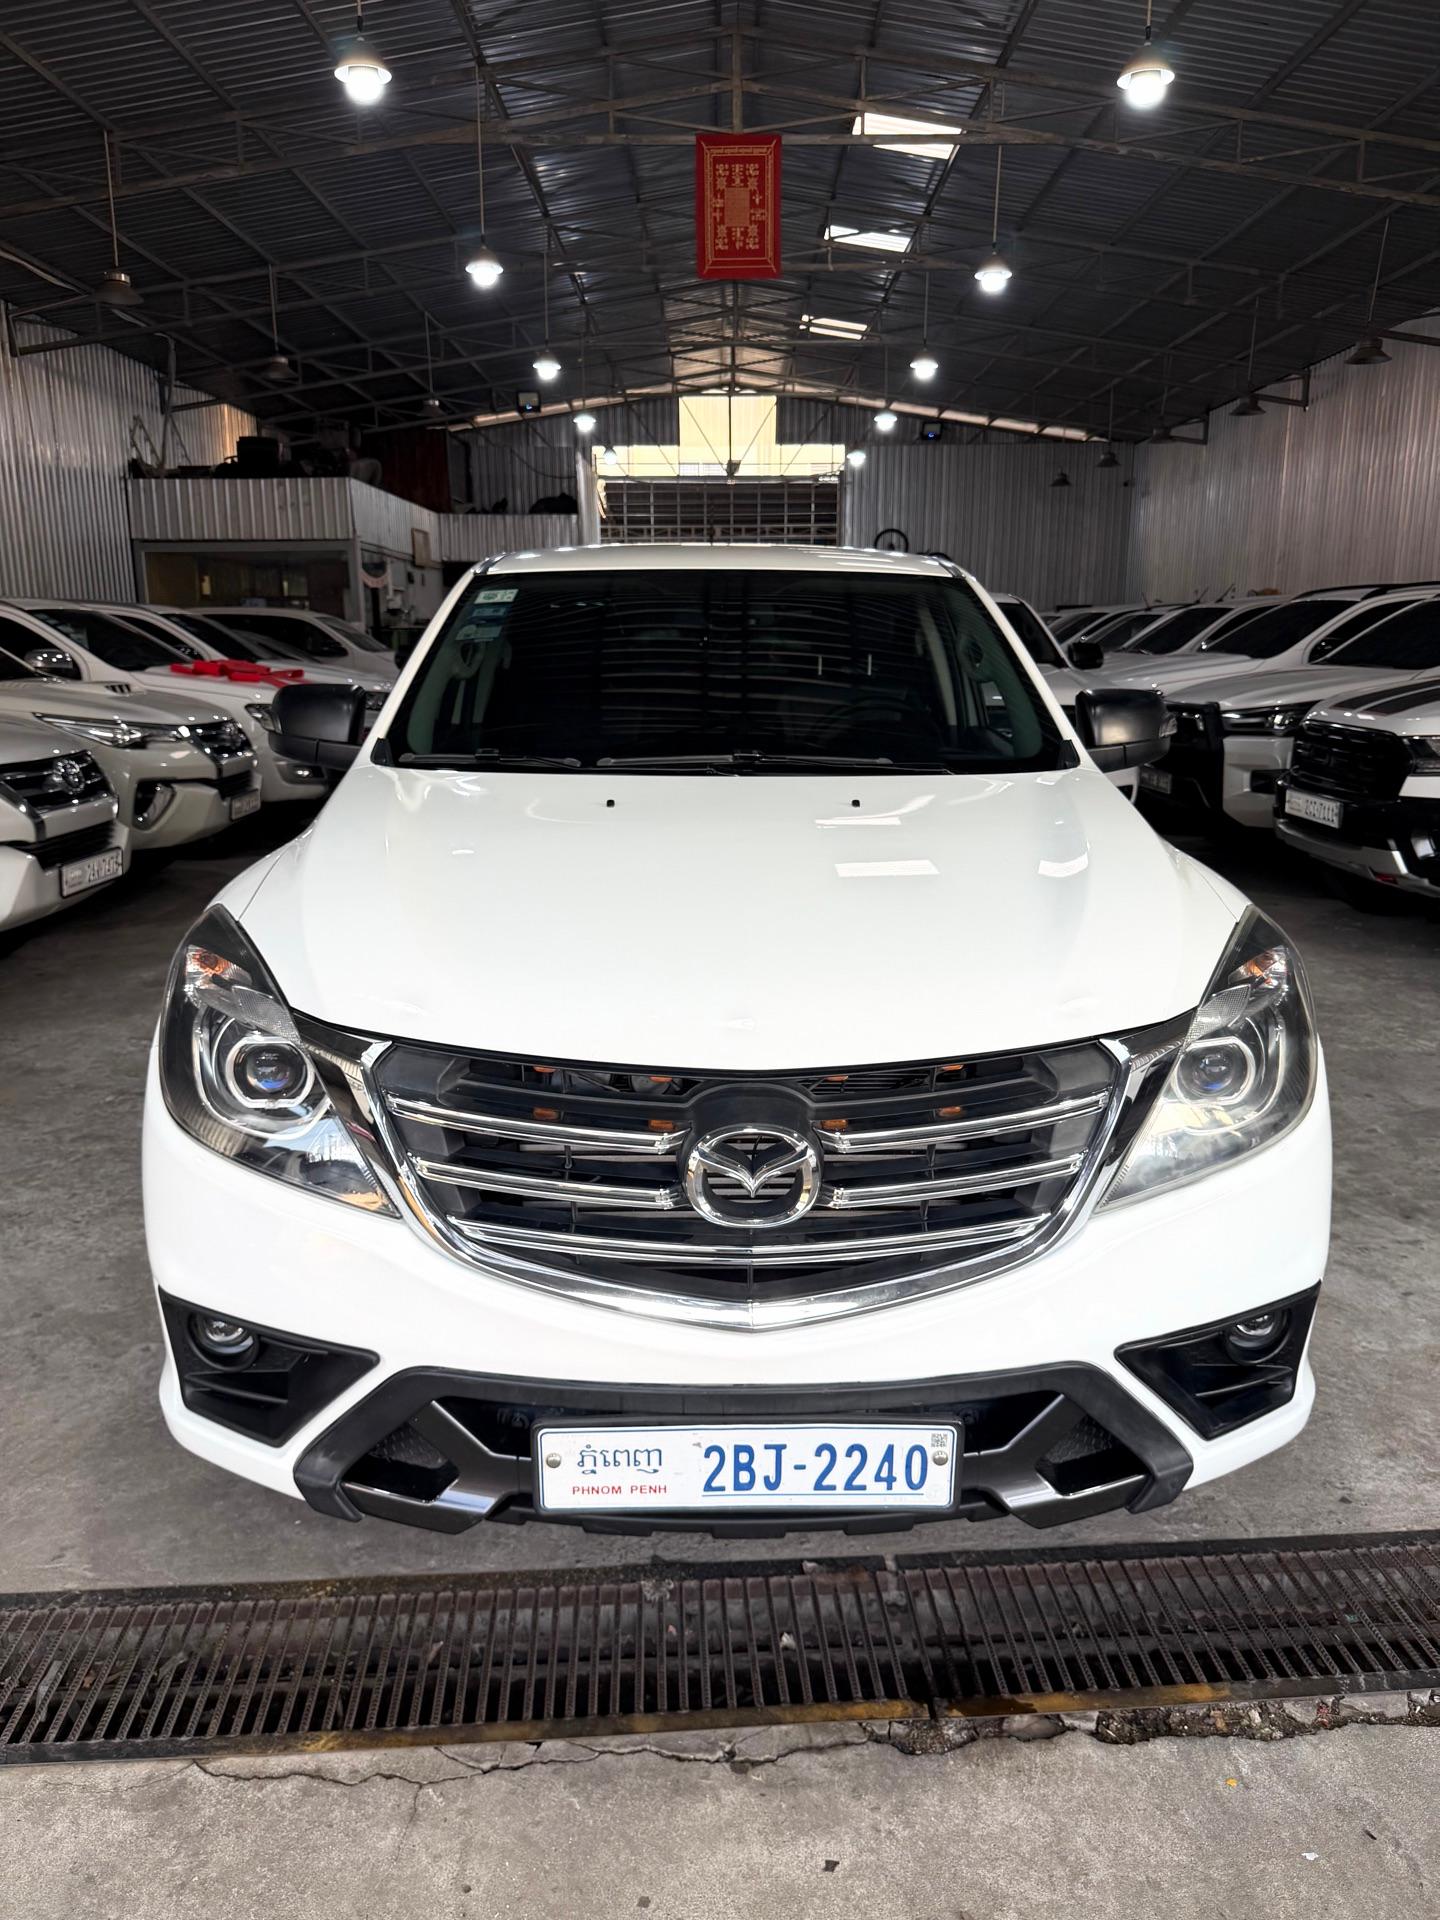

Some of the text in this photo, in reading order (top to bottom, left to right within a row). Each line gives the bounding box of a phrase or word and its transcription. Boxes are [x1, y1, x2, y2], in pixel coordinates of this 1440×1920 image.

[577, 1444, 662, 1475] ភ្នំពេញ
[703, 1443, 928, 1492] 2BJ-2240
[572, 1484, 667, 1495] PHNOM PENH
